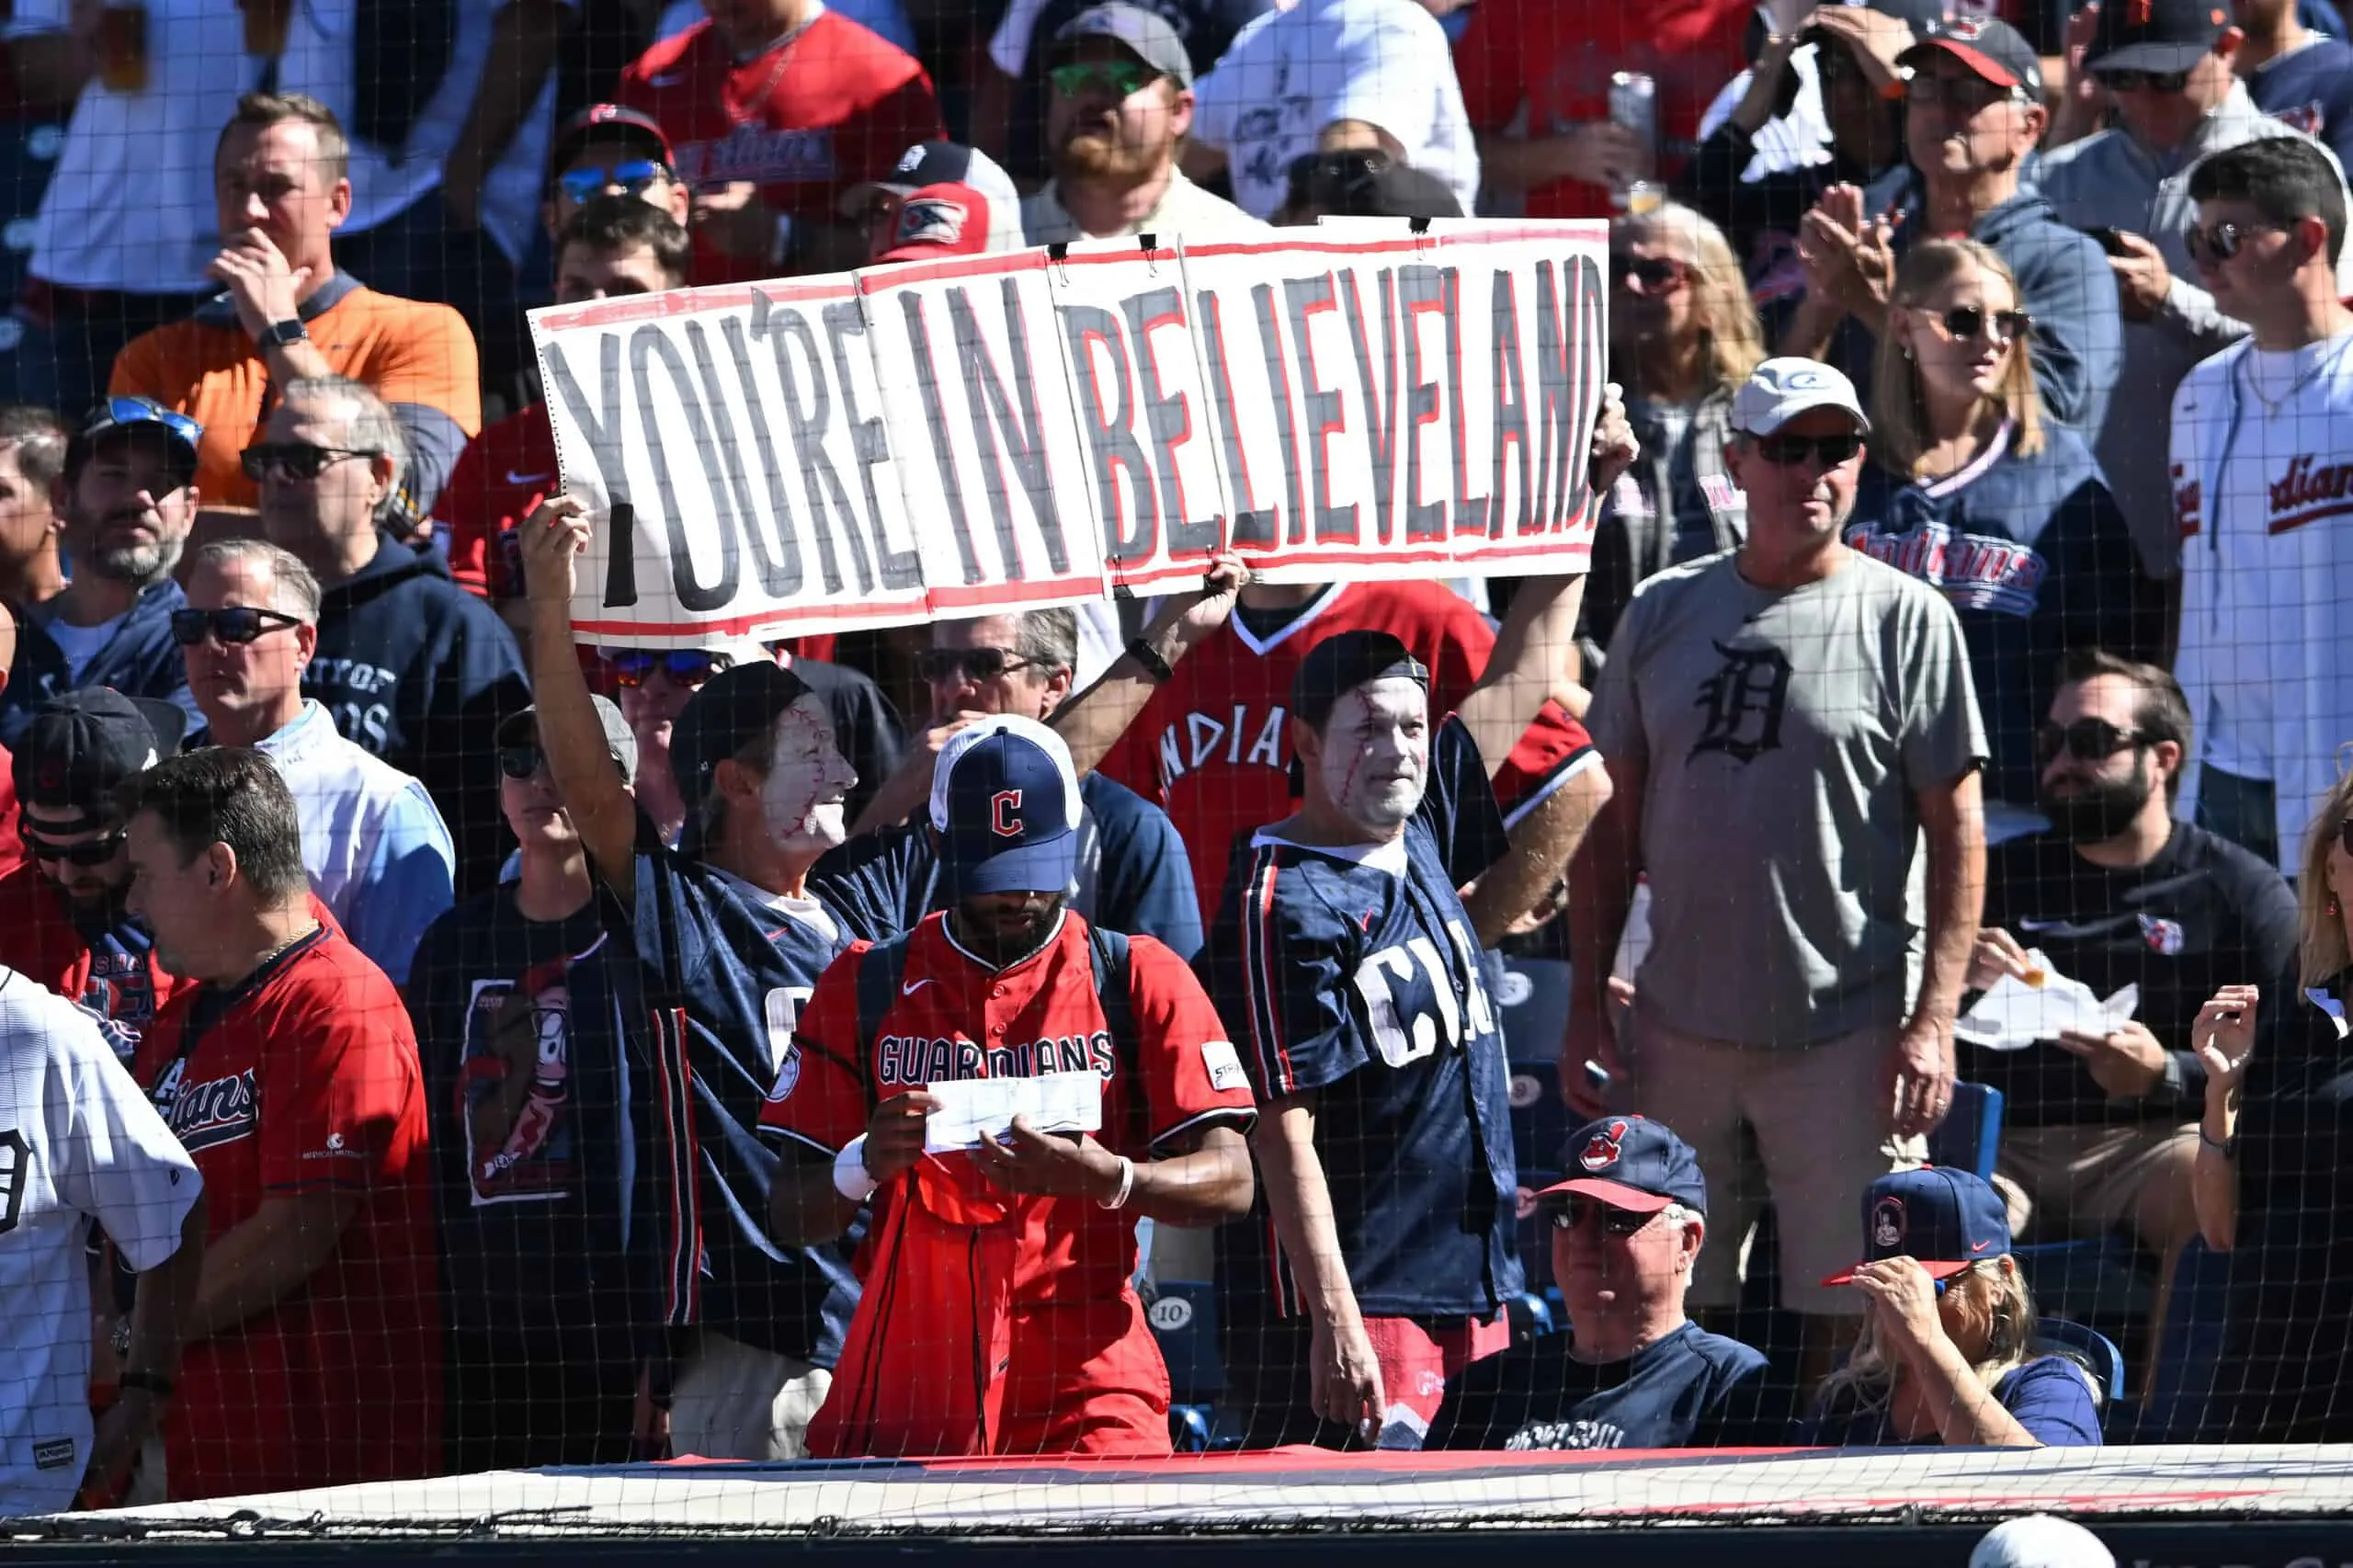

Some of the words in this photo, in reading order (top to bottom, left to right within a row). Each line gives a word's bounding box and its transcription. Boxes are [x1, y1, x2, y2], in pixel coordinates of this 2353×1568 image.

[542, 286, 923, 612] YOU'RE
[898, 278, 1070, 585] IN
[1055, 255, 1603, 572] BELIEVELAND
[1160, 705, 1291, 789] NDIA
[992, 789, 1023, 837] C
[879, 1030, 1115, 1086] GUARDIANS
[1158, 1304, 1184, 1323] 10
